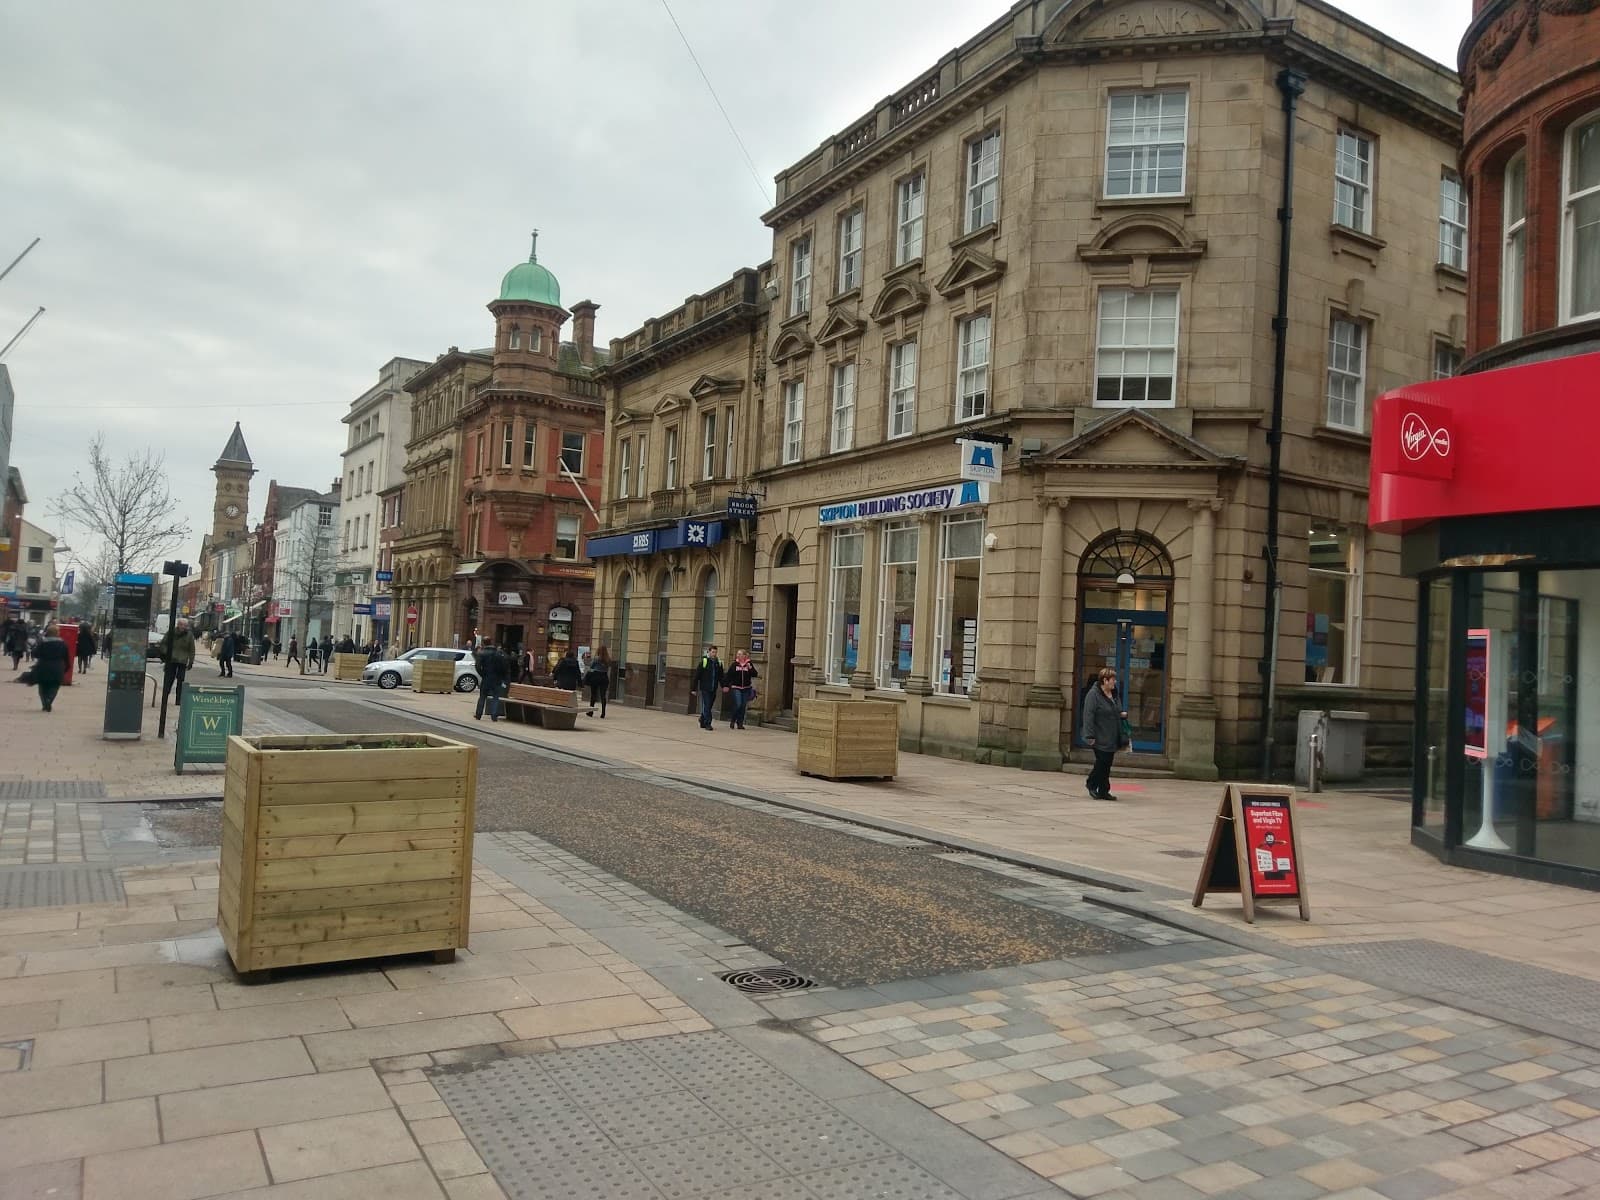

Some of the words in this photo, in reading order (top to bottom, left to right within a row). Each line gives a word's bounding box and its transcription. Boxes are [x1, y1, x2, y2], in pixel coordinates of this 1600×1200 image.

[1114, 7, 1189, 37] BANK
[1405, 421, 1426, 453] Virgin
[728, 507, 756, 516] STREET
[731, 501, 754, 509] BROOK
[820, 503, 857, 522] SKIPTON
[858, 496, 905, 517] BUILDING
[906, 488, 954, 509] SOCIETY
[192, 695, 235, 705] Winckleys
[203, 716, 222, 730] W
